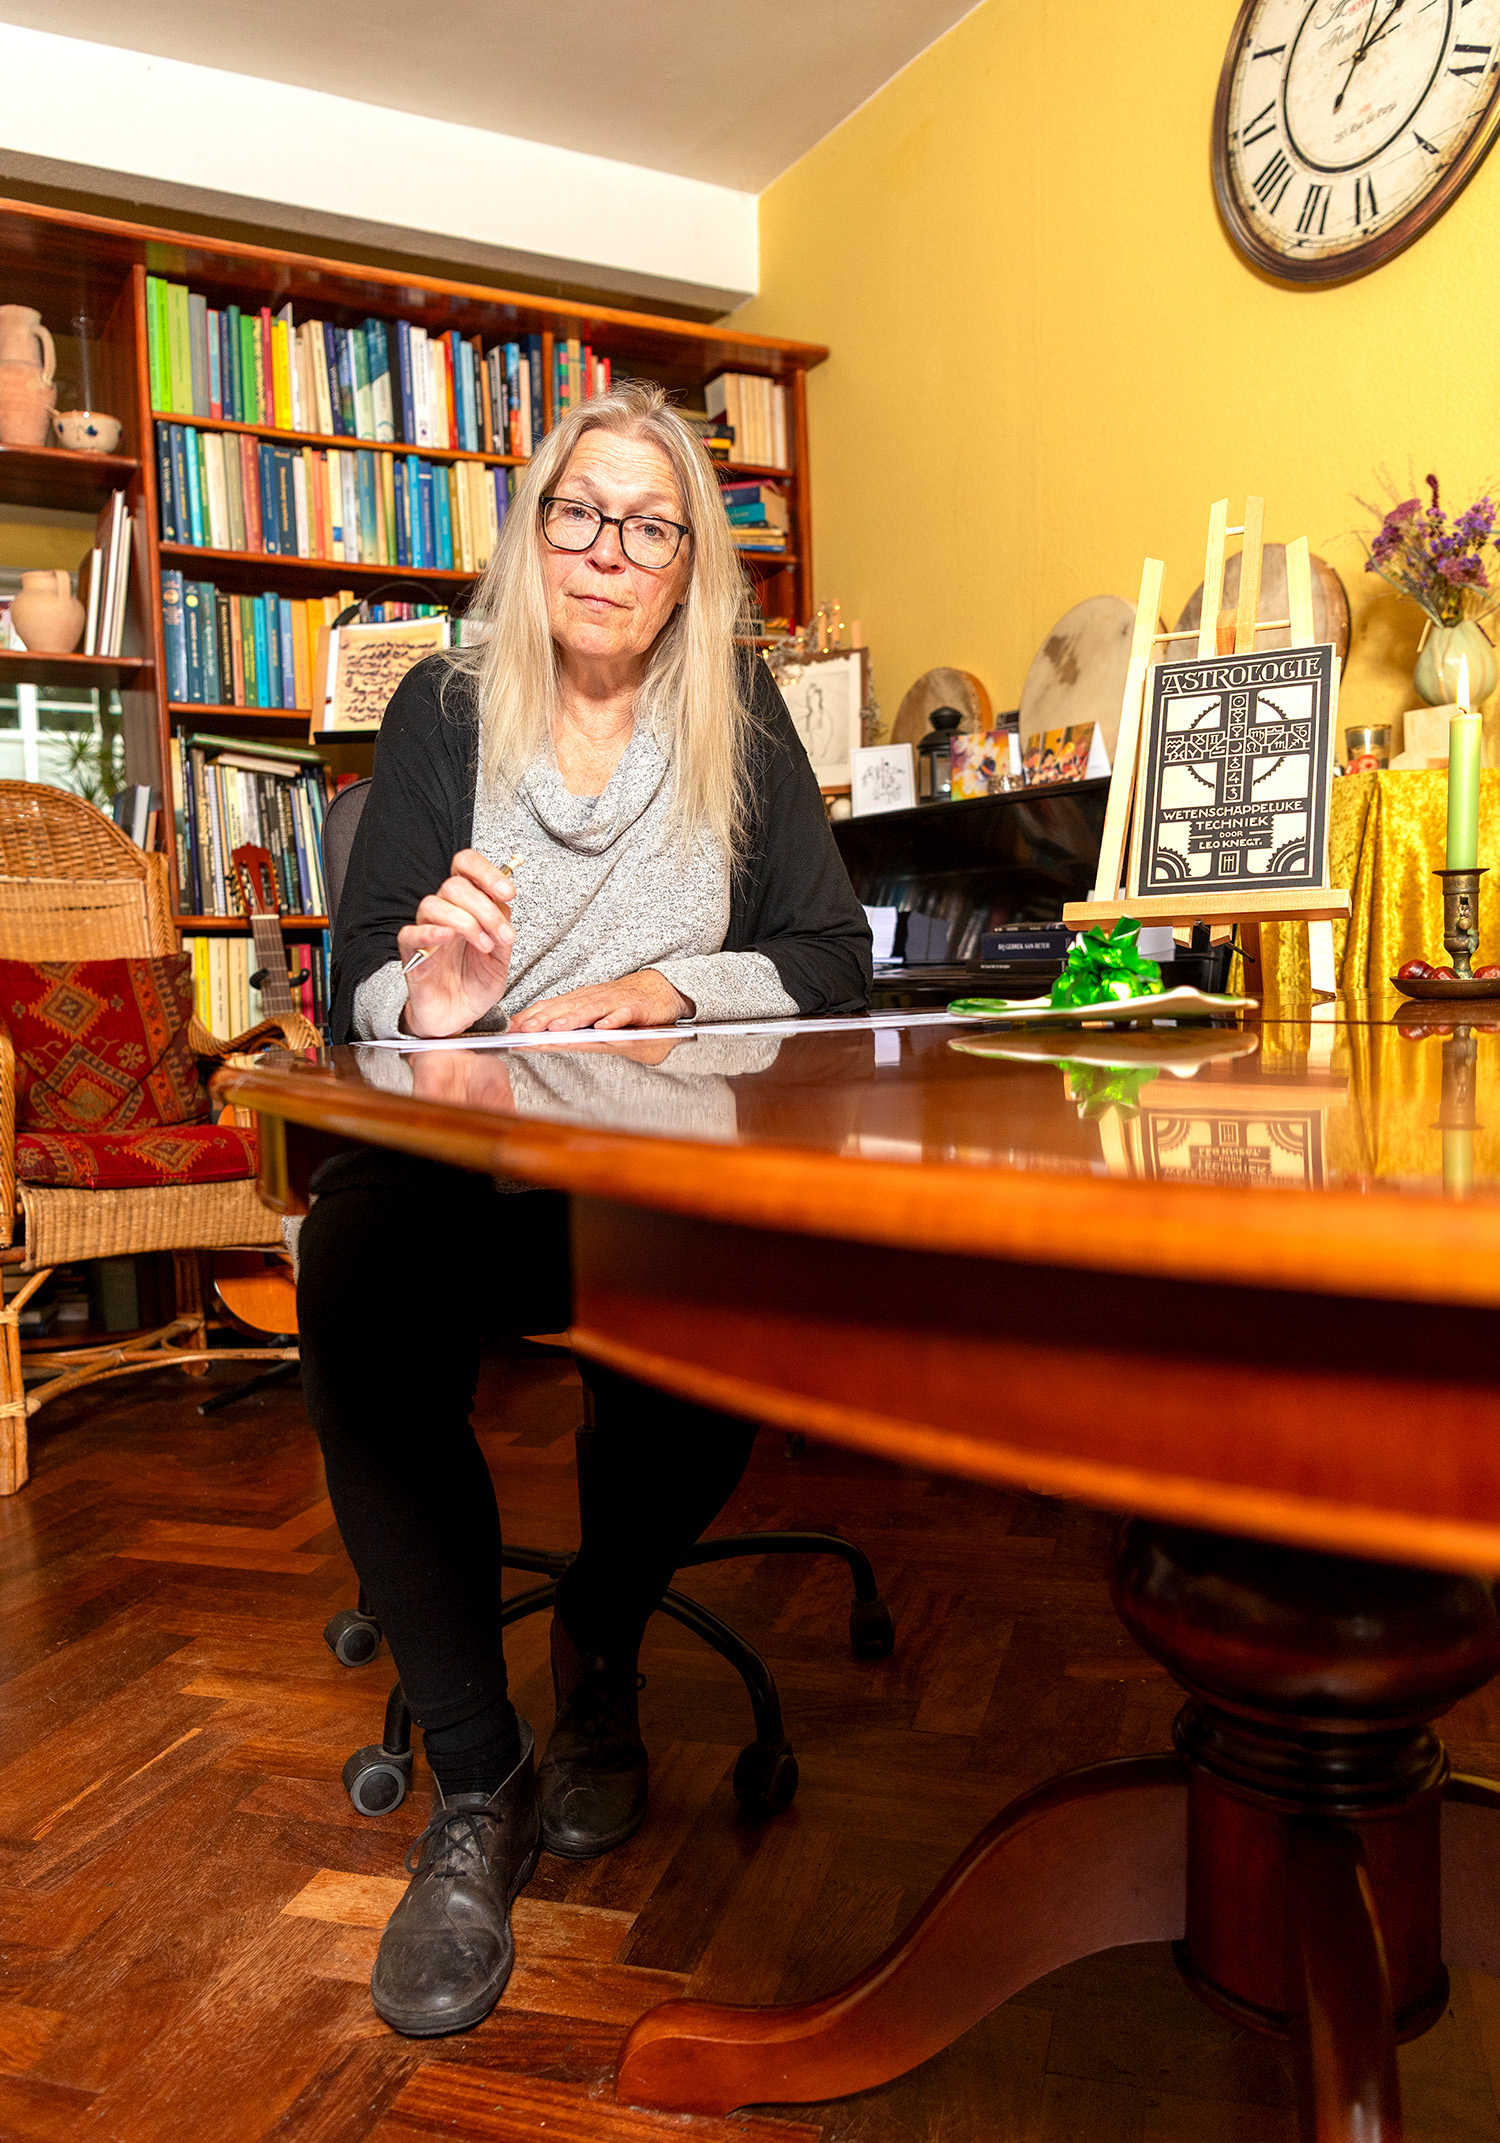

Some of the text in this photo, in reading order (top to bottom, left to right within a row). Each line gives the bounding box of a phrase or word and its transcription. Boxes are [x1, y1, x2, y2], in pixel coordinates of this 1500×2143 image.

[1161, 657, 1323, 694] ASTROLOGIE
[1195, 816, 1269, 831] TECHNIEK
[1219, 830, 1243, 838] DOOR
[1198, 840, 1221, 849] LEO
